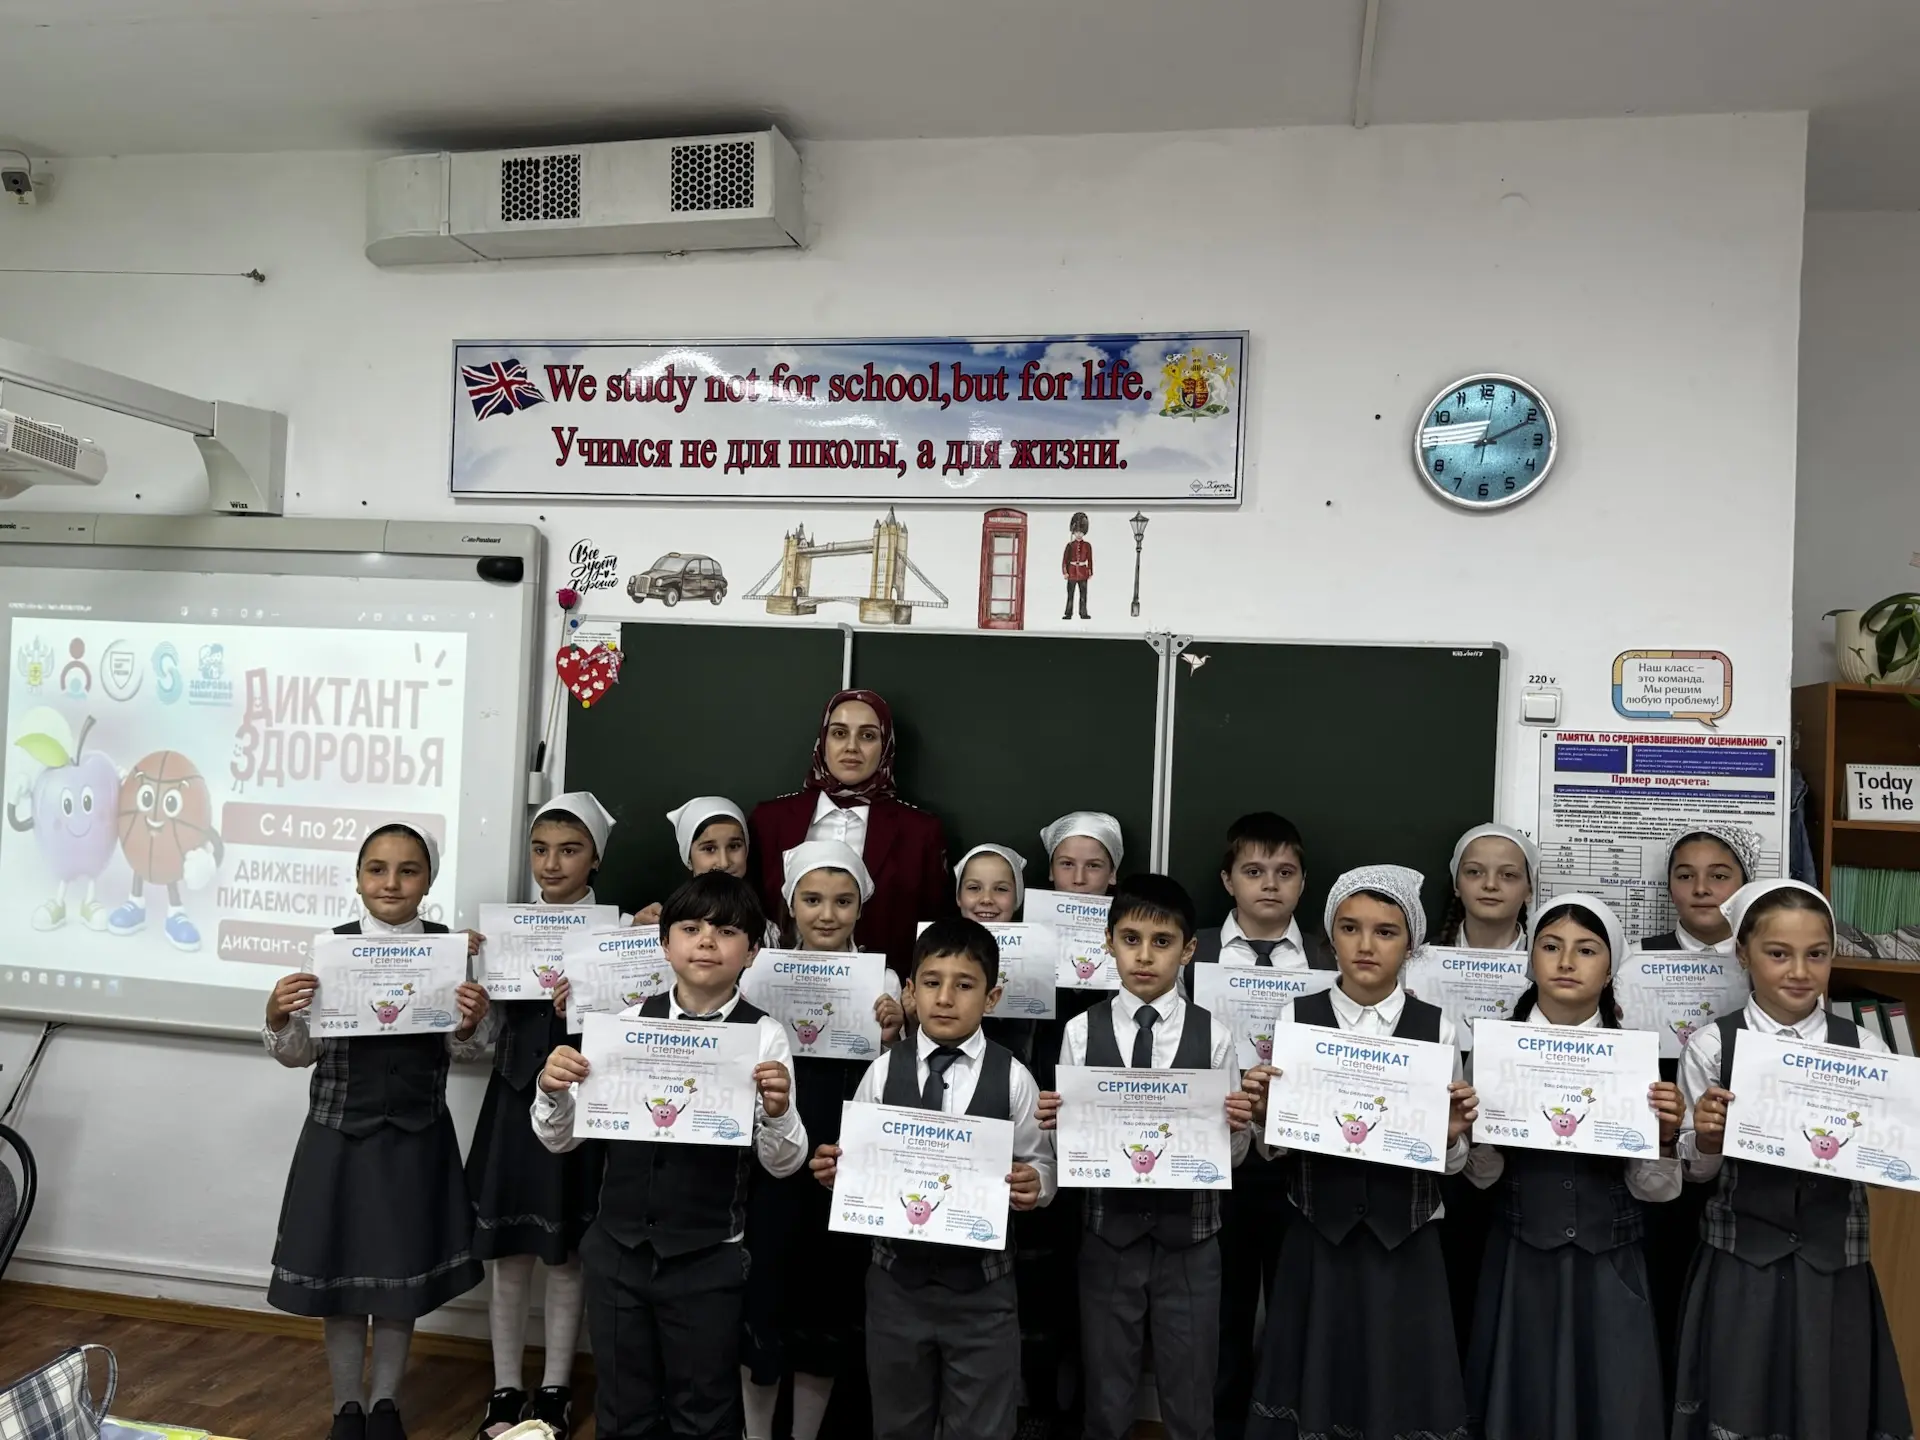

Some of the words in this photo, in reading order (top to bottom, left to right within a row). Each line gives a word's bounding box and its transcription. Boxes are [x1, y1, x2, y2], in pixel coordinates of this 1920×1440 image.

[544, 364, 596, 402] We
[606, 363, 697, 413] study
[705, 368, 760, 402] not
[769, 363, 820, 402] for
[1019, 360, 1074, 401] for
[1082, 359, 1152, 401] life.
[1480, 384, 1495, 400] 12
[1456, 392, 1466, 407] 11
[1511, 391, 1516, 406] 1
[1435, 411, 1450, 423] 10
[1527, 409, 1537, 422] 2
[1533, 433, 1543, 447] 3
[551, 426, 672, 468] Учимся
[680, 439, 717, 468] не
[724, 439, 780, 474] для
[788, 439, 907, 477] школы,
[917, 440, 935, 469] а
[942, 440, 1002, 475] для
[1009, 439, 1128, 470] жизни.
[1434, 459, 1444, 472] 8
[1526, 459, 1535, 471] 4
[1454, 478, 1462, 492] 7
[1478, 483, 1489, 496] 6
[1505, 477, 1515, 490] 5
[1638, 663, 1661, 672] Наш
[1529, 675, 1547, 684] 220
[1637, 675, 1655, 683] это
[1658, 675, 1704, 684] команда.
[1643, 685, 1661, 693] Мы
[1664, 686, 1701, 695] решим
[243, 667, 429, 729] ДИКТАНТ
[1626, 696, 1661, 706] любую
[1664, 696, 1719, 706] проблему!
[1556, 733, 1595, 743] ПАМЯТКА
[1599, 734, 1610, 743] ПО
[1612, 734, 1706, 746] СРЕДНЕВЗВЕШЕННОМУ
[1708, 737, 1768, 747] ОЦЕНИВАНИЮ
[230, 723, 445, 788] ЗДОРОВЬЯ
[1611, 774, 1651, 786] Пример
[1655, 776, 1710, 787] подсчета:
[1854, 771, 1913, 794] Today
[1858, 792, 1872, 810] is
[1881, 791, 1914, 810] the
[260, 813, 275, 836] С
[282, 814, 293, 836] 4
[300, 821, 325, 839] по
[332, 817, 357, 840] 22
[235, 859, 339, 886] ДВИЖЕНИЕ
[217, 887, 317, 917] ПИТАЕМСЯ
[1056, 904, 1106, 917] СЕРТИФИ
[514, 915, 587, 925] СЕРТИФИКАТ
[598, 937, 659, 952] СЕРТИФИК
[352, 947, 432, 958] СЕРТИФИКАТ
[774, 962, 850, 976] СЕРТИФИКАТ
[1442, 960, 1522, 974] СЕРТИФИКАТ
[1641, 964, 1724, 975] СЕРТИФИКАТ
[795, 975, 831, 983] степени
[1229, 977, 1306, 992] СЕРТИФИКАТ
[1251, 990, 1288, 998] степени
[626, 1032, 718, 1049] СЕРТИФИКАТ
[1518, 1038, 1614, 1056] СЕРТИФИКАТ
[652, 1046, 695, 1055] степени
[1316, 1042, 1409, 1066] СЕРТИФИКАТ
[1545, 1053, 1590, 1063] степени
[1342, 1059, 1385, 1072] степени
[1782, 1053, 1889, 1082] СЕРТИФИКАТ
[1811, 1072, 1861, 1086] степени
[664, 1085, 684, 1093] /100
[1097, 1081, 1188, 1094] СЕРТИФИКАТ
[1124, 1093, 1166, 1101] степени
[1561, 1094, 1582, 1103] /100
[1353, 1101, 1374, 1110] /100
[1824, 1115, 1847, 1125] /100
[882, 1121, 973, 1143] СЕРТИФИКАТ
[1140, 1130, 1159, 1139] /100
[908, 1137, 950, 1149] степени
[919, 1180, 938, 1189] /100
